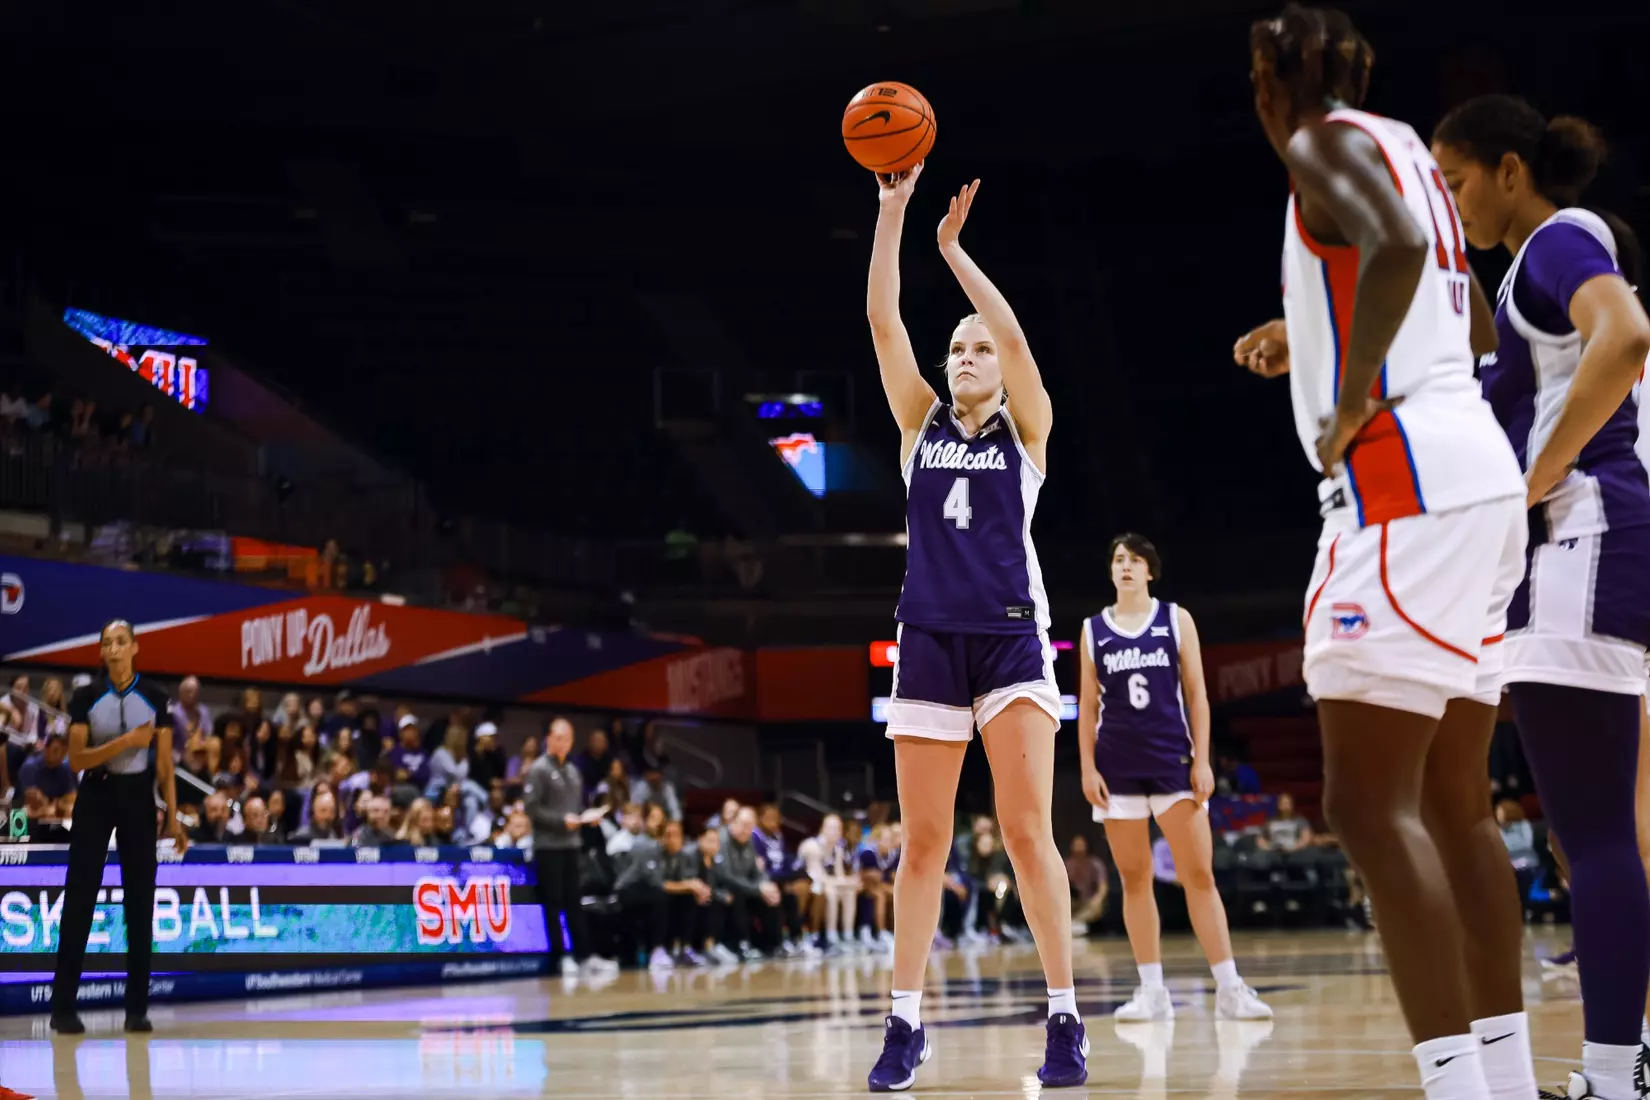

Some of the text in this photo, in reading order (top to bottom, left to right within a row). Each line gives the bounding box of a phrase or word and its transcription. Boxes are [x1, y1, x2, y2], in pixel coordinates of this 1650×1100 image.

[920, 438, 1008, 471] Wildcats
[943, 477, 972, 530] 4
[241, 602, 391, 677] PONY UP Dallas
[1103, 646, 1171, 675] Wildcats
[1127, 672, 1151, 710] 6
[0, 886, 279, 947] SKEBALL
[412, 875, 512, 945] SMU
